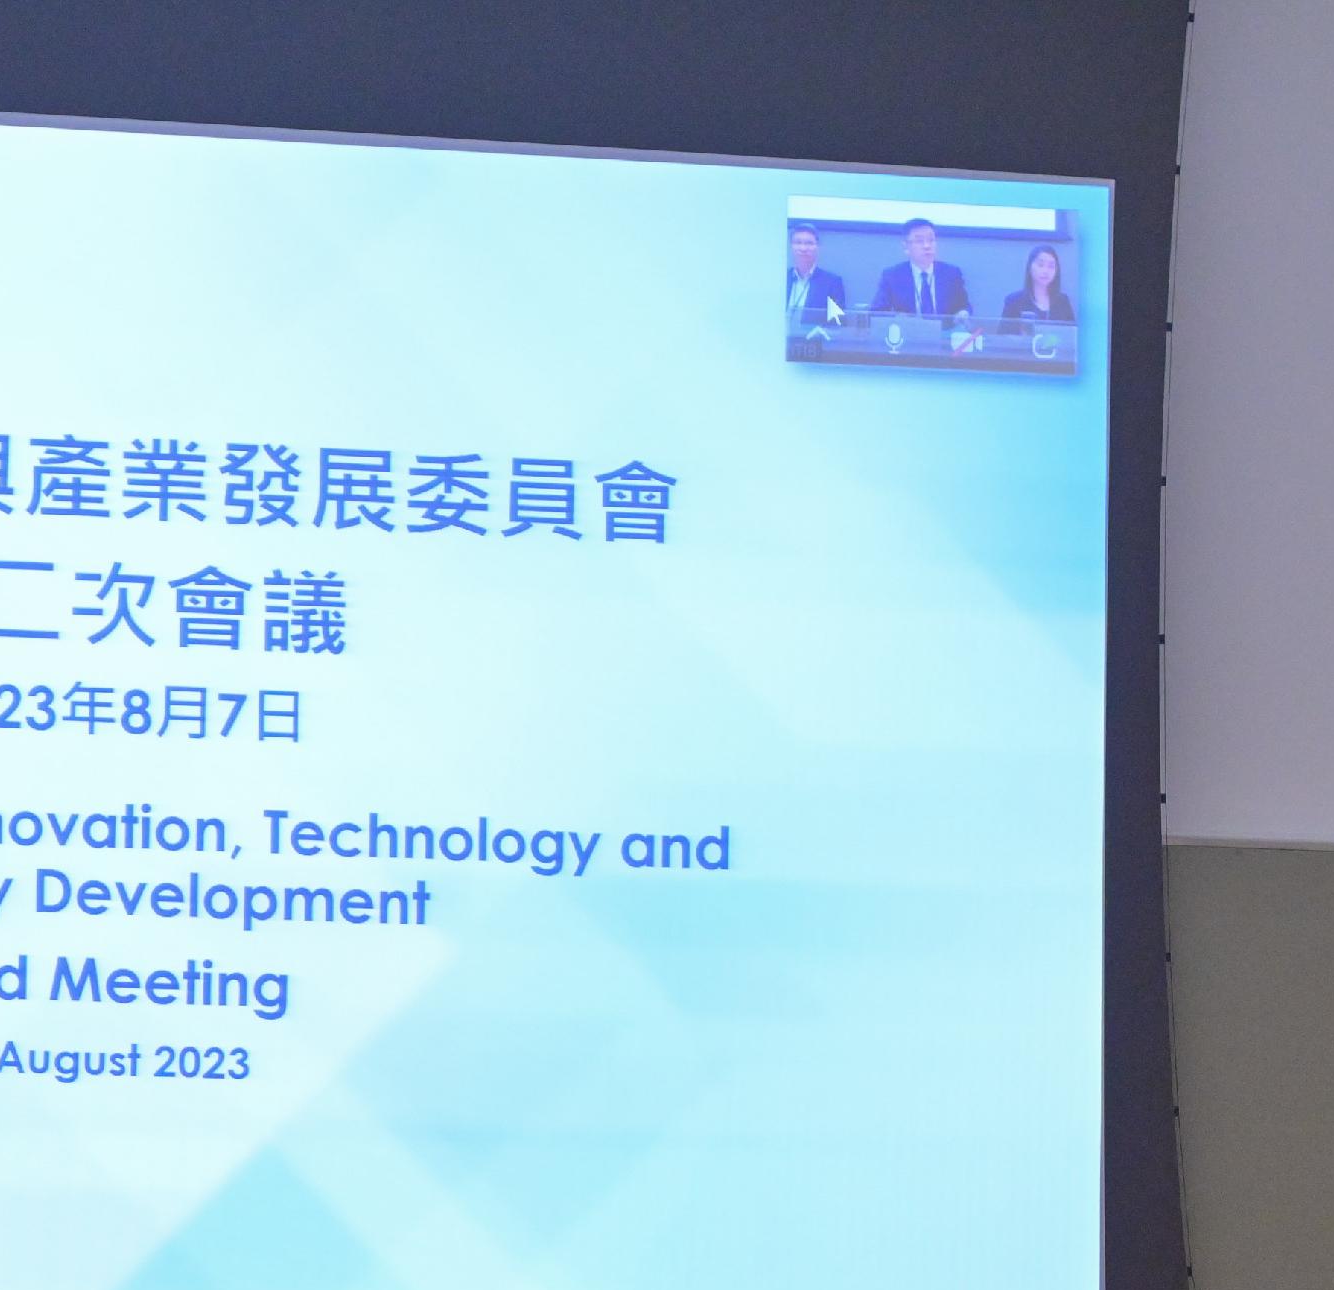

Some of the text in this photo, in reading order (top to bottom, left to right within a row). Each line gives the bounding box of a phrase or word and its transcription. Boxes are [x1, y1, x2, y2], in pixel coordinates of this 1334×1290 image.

[263, 809, 603, 878] Technology
[621, 825, 730, 871] and
[36, 868, 432, 932] Development
[49, 956, 289, 1021] Meeting
[153, 1045, 250, 1080] 2023
